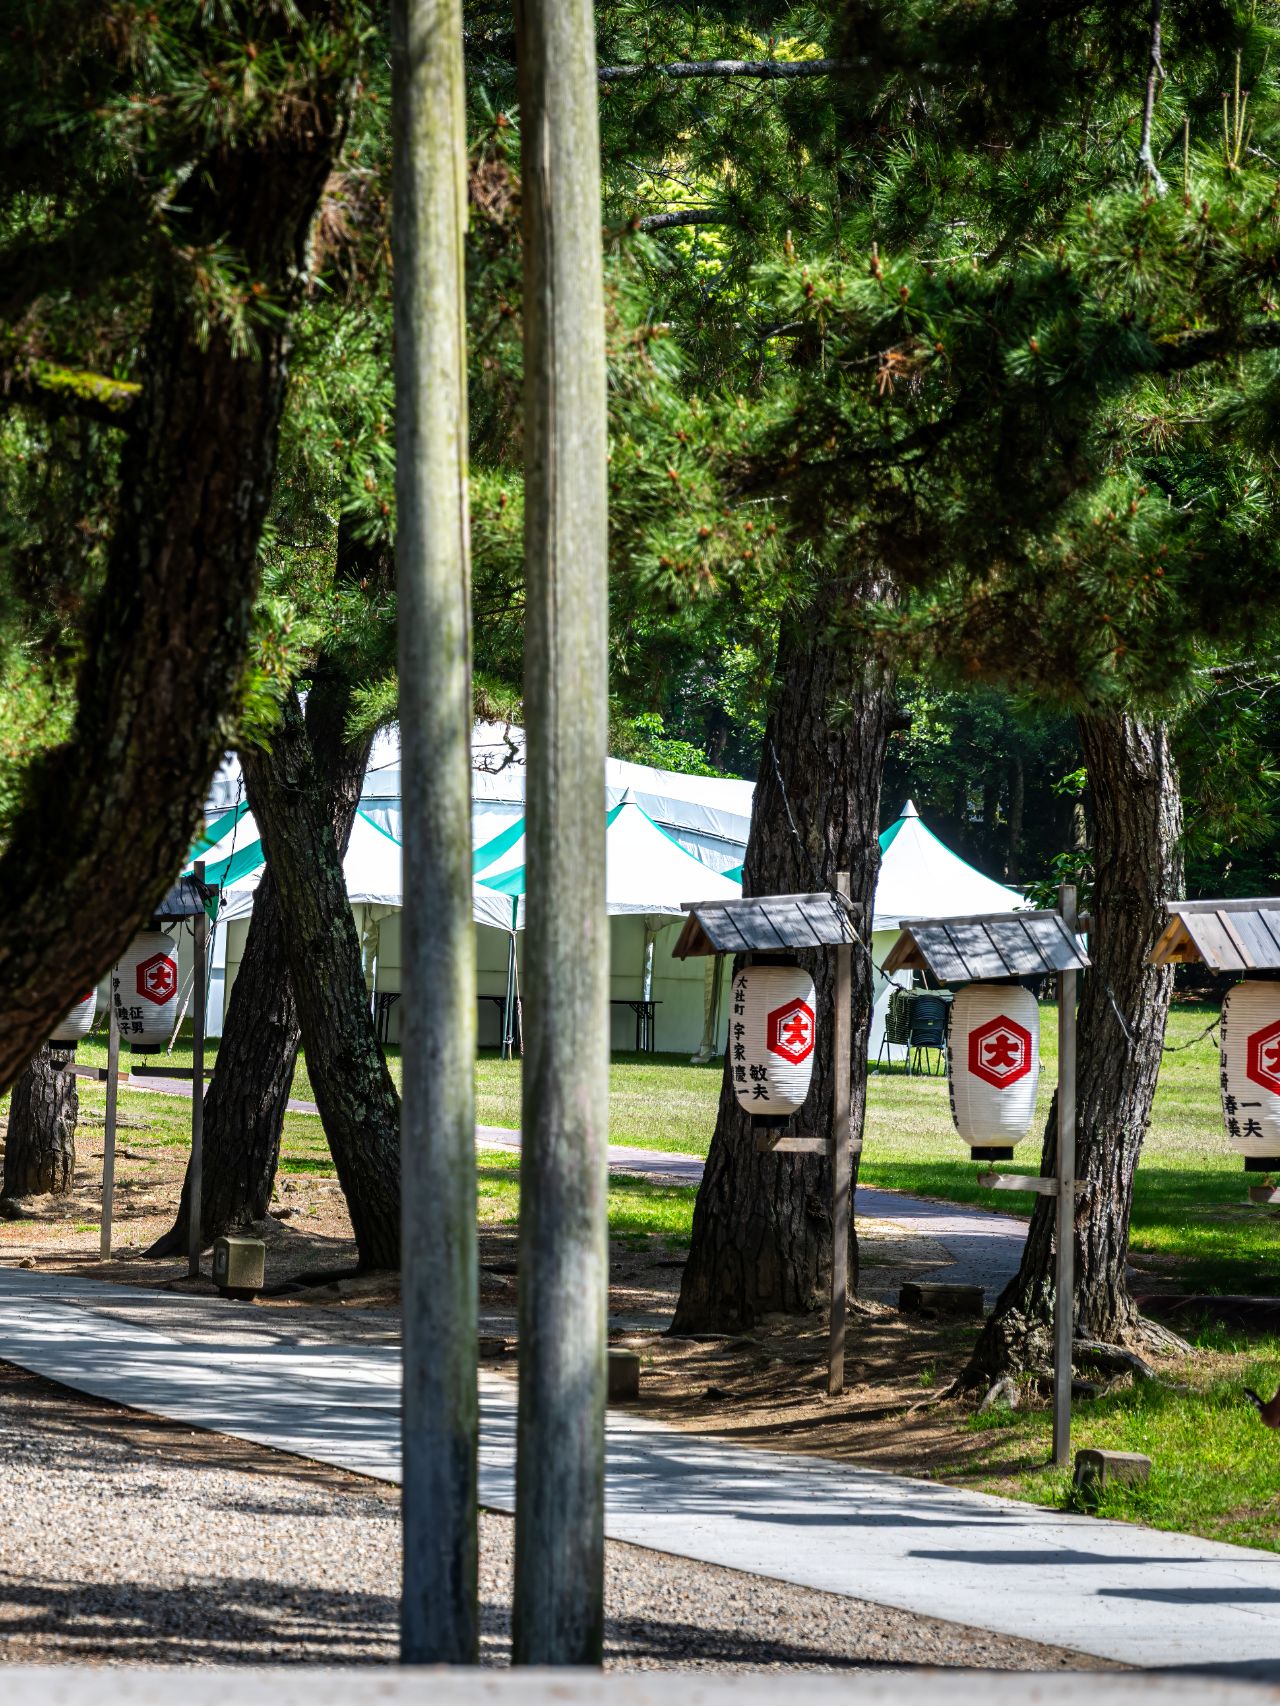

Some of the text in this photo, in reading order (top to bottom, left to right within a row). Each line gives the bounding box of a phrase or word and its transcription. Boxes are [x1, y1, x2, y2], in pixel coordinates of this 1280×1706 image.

[148, 966, 171, 990] 大
[783, 1014, 808, 1045] 大
[984, 1033, 1019, 1068] 大
[750, 1064, 770, 1101] 敏夫
